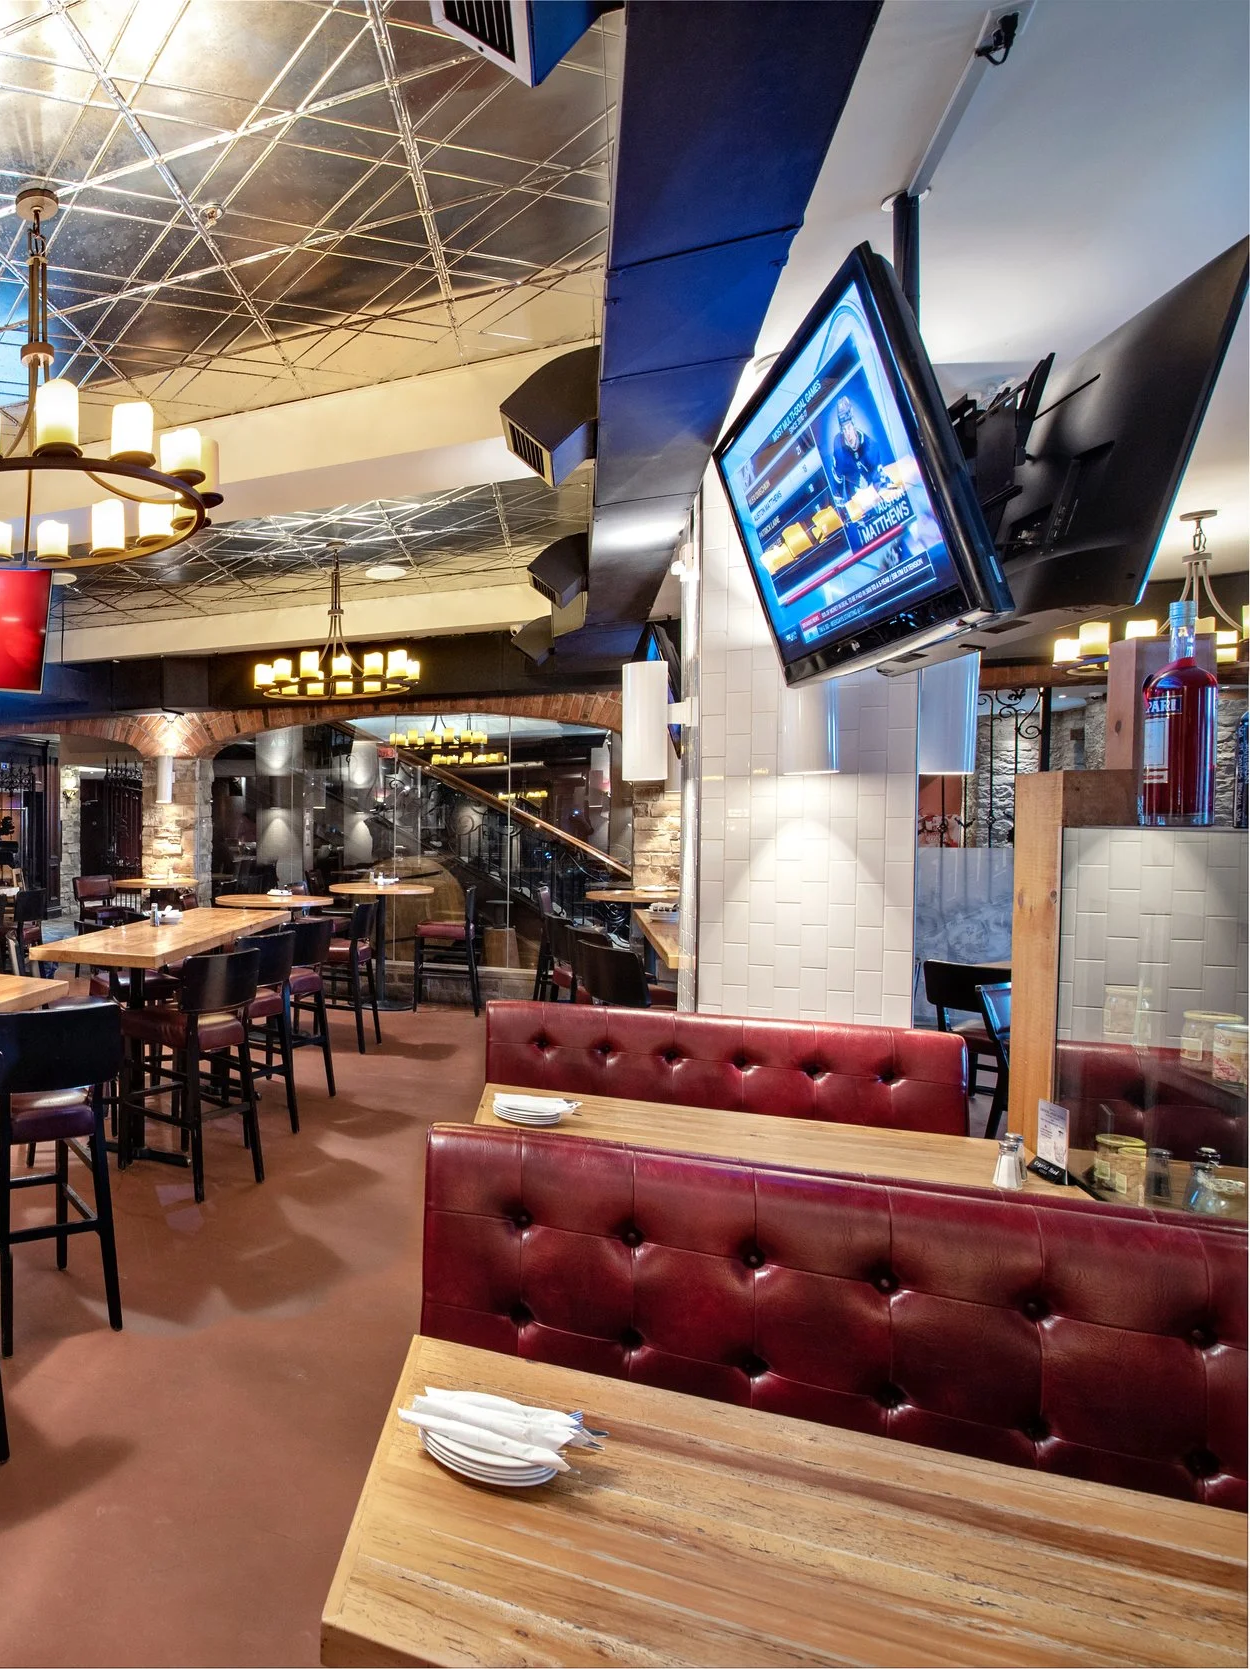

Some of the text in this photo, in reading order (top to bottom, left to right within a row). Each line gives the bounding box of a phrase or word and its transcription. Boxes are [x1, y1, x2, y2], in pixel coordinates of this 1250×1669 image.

[772, 380, 821, 443] MOST MULTI-GOAL GAMES
[753, 506, 766, 523] AUSTON
[764, 489, 782, 511] MATTHEWS
[862, 501, 909, 543] MATTHEWS
